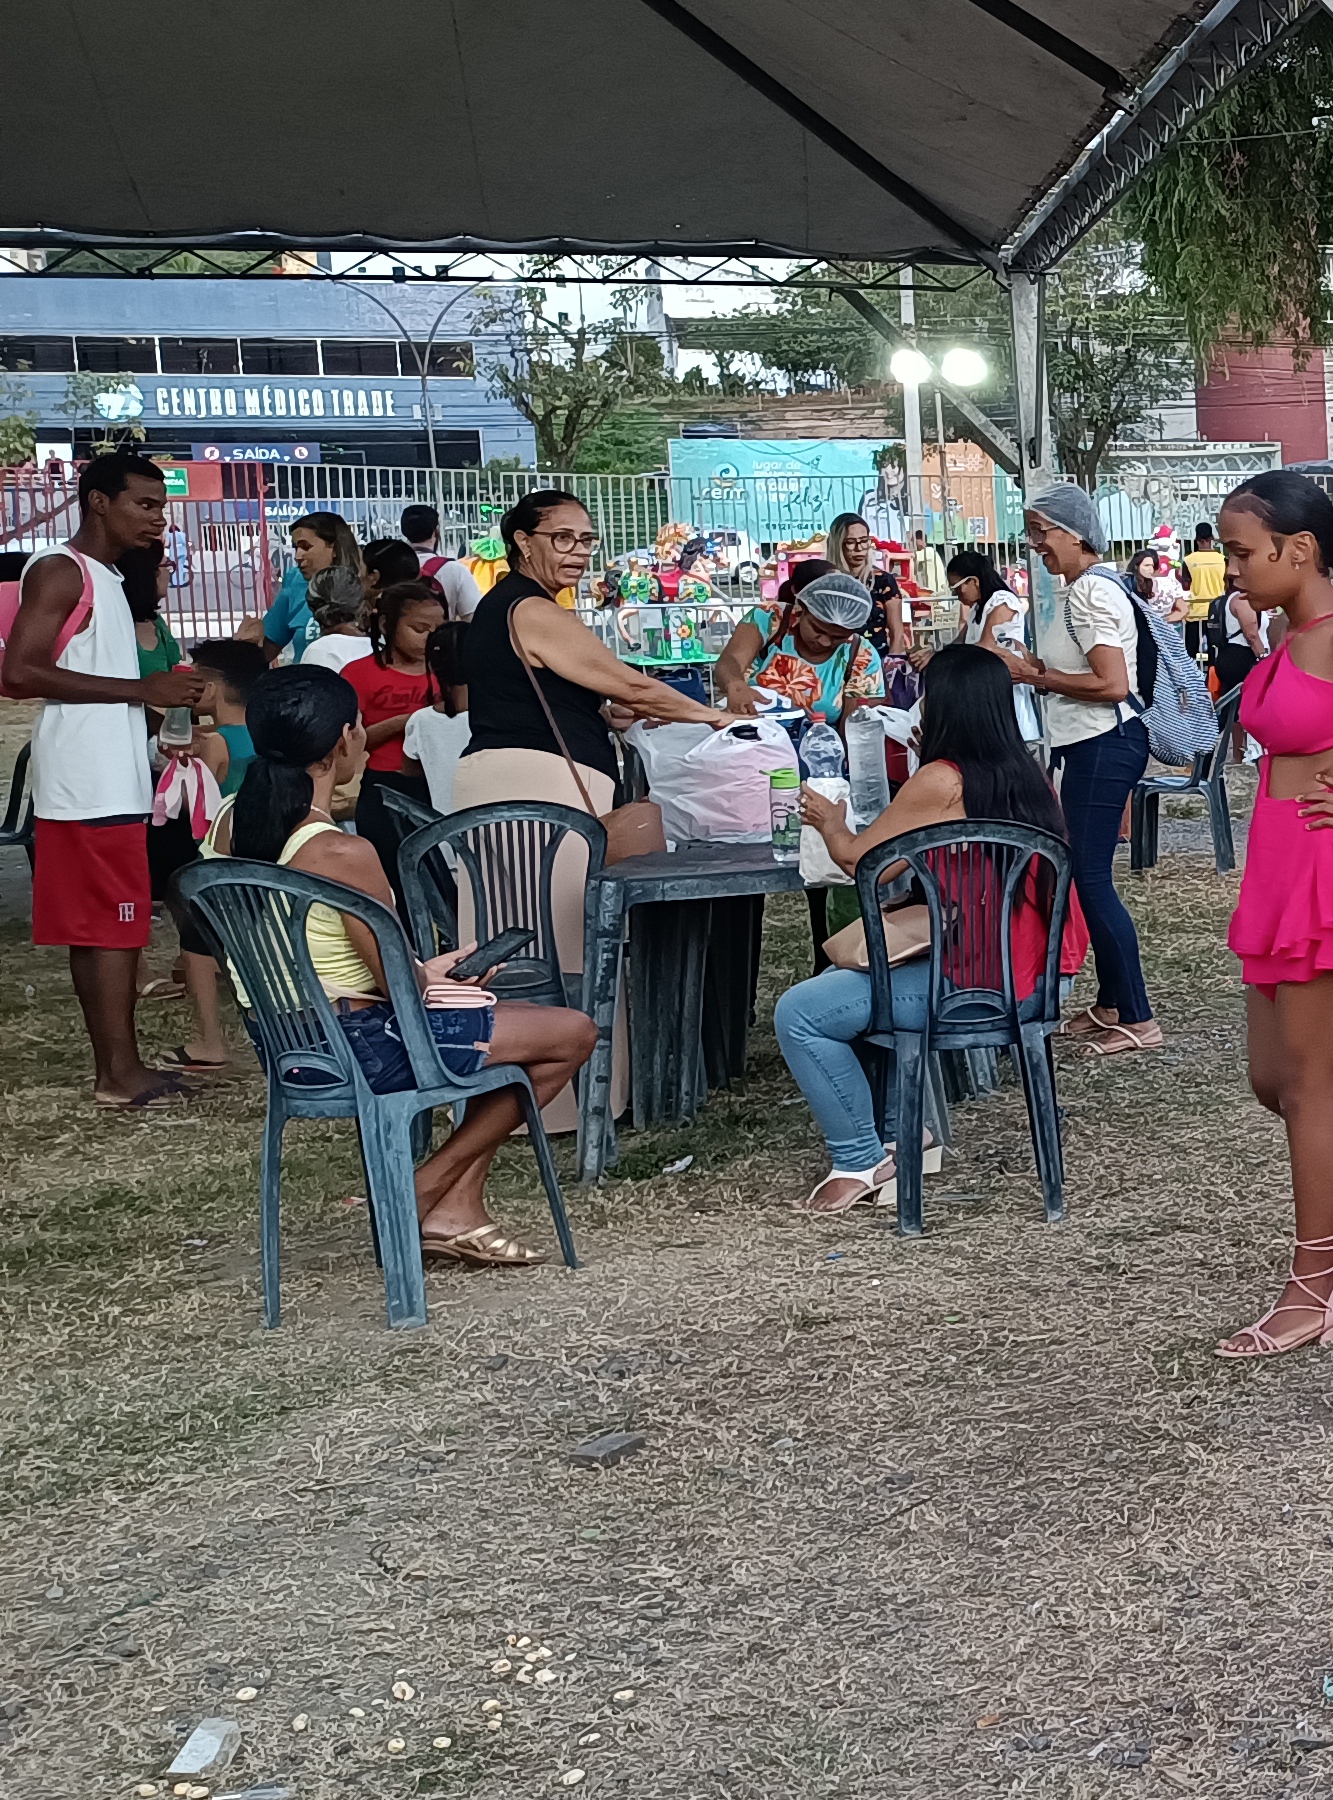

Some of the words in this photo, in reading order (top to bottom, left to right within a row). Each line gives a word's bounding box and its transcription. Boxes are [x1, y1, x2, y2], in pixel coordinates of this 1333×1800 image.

[156, 387, 237, 418] CENTRO
[244, 385, 325, 417] MÉDICO
[330, 389, 396, 417] TRADE
[232, 445, 281, 460] SAÍDA
[264, 503, 310, 517] SAÍDA
